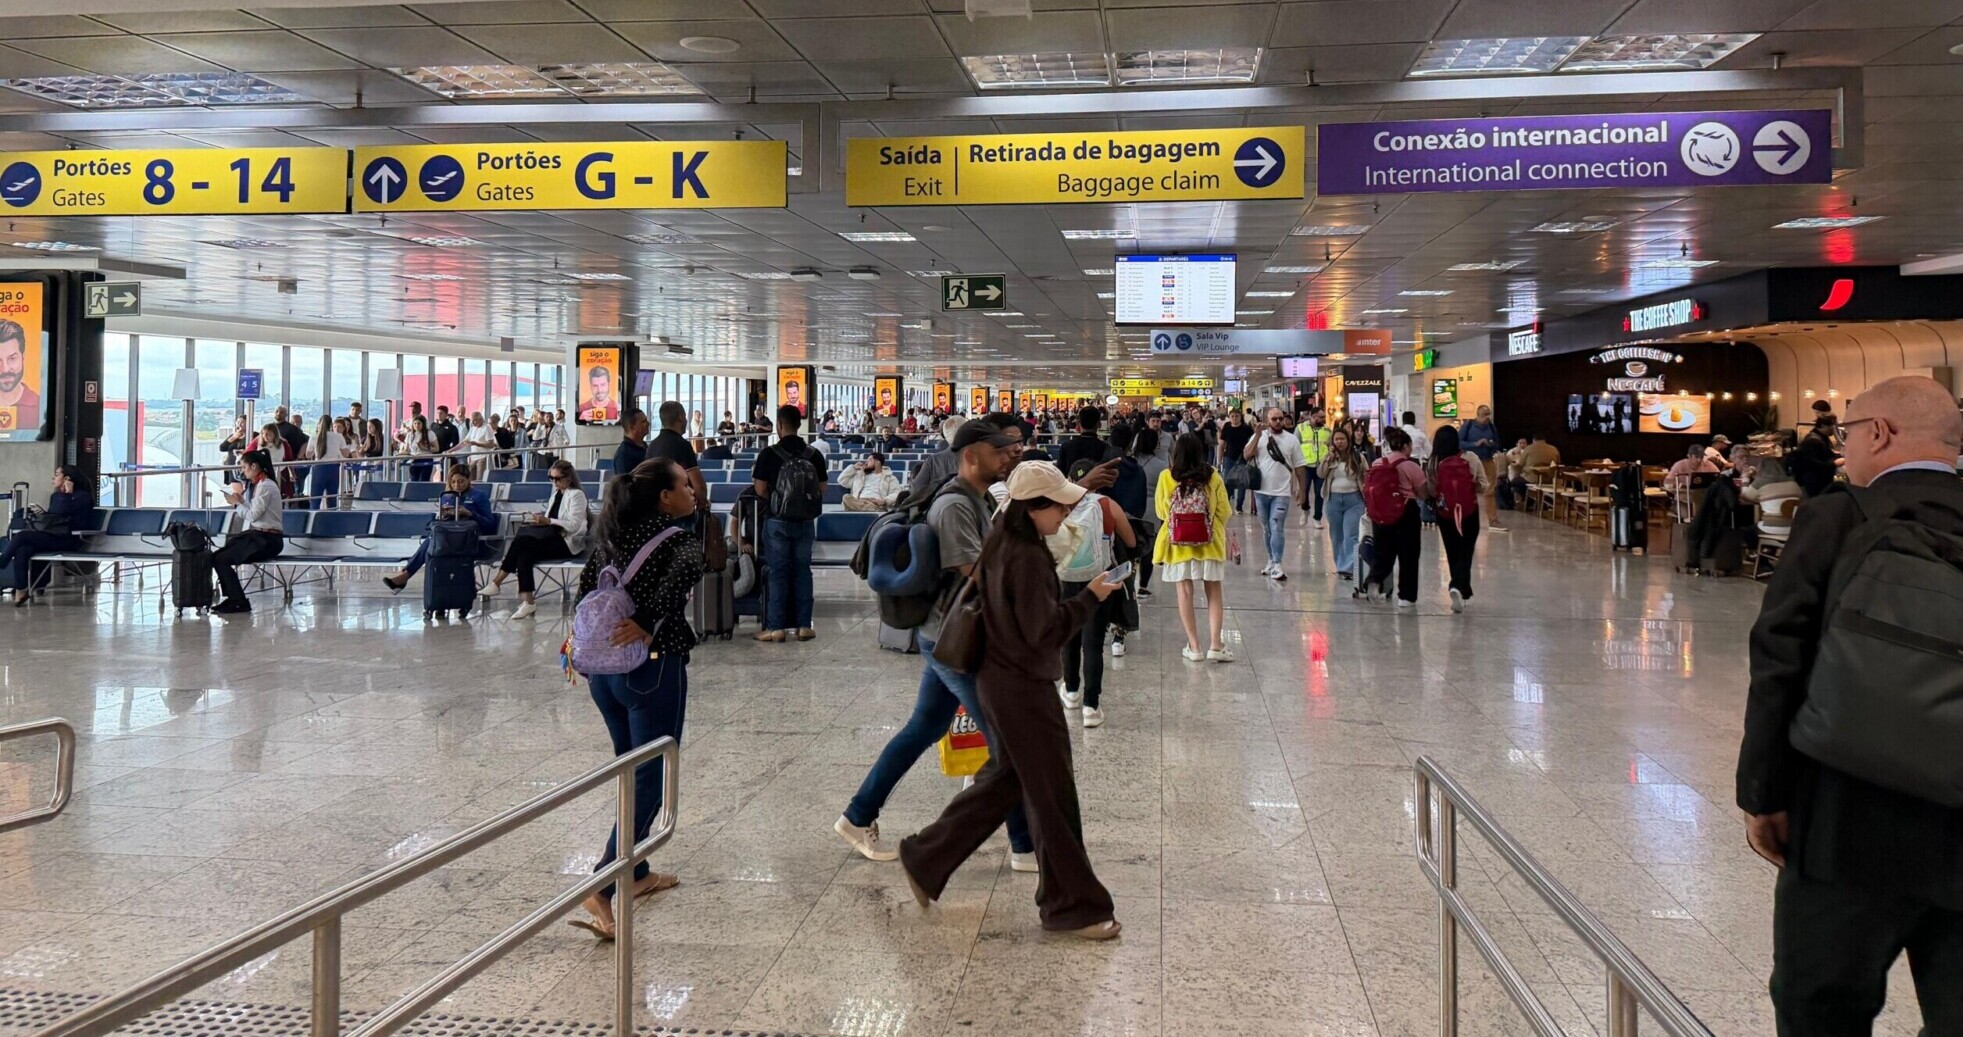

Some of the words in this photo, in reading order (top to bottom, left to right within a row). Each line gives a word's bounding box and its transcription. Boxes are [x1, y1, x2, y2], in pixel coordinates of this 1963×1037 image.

[1373, 126, 1486, 153] Conexão
[1492, 120, 1668, 149] internacional
[477, 150, 562, 170] Portões
[879, 143, 943, 166] Saída
[969, 141, 1069, 163] Retirada
[1073, 139, 1101, 161] de
[1108, 138, 1221, 165] bagagem
[53, 157, 132, 177] Portões
[574, 151, 616, 200] G
[672, 151, 710, 199] K
[1365, 159, 1520, 186] International
[1528, 155, 1668, 182] connection
[143, 158, 175, 206] 8
[230, 157, 296, 204] 14
[904, 176, 943, 196] Exit
[1057, 173, 1156, 198] Baggage
[1160, 170, 1221, 191] claim
[52, 189, 106, 208] Gates
[476, 183, 534, 201] Gates
[16, 291, 24, 300] o
[1630, 309, 1645, 332] THE
[1644, 303, 1670, 330] COFFEE
[1669, 299, 1691, 325] SHOP
[1196, 332, 1214, 340] Sala
[1215, 332, 1229, 341] Vip
[1196, 343, 1208, 351] VIP
[1209, 343, 1240, 352] Lounge
[1599, 349, 1616, 363] THE
[953, 714, 978, 734] LEG
